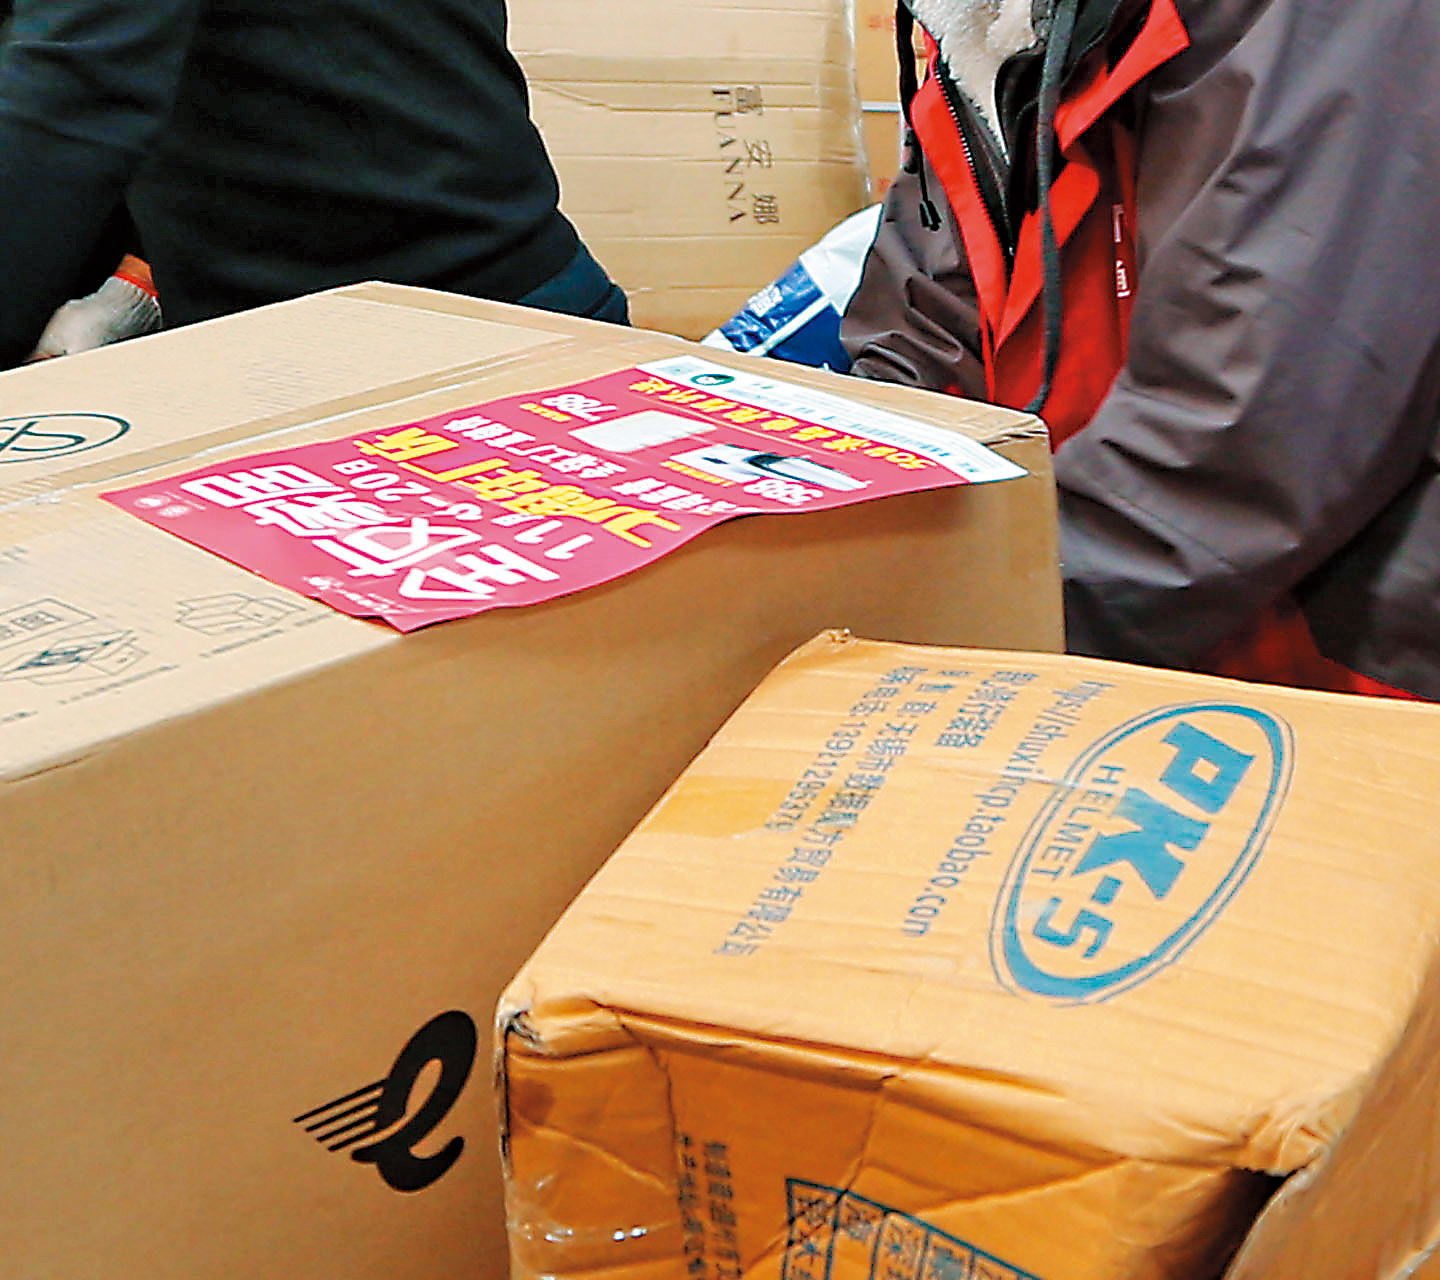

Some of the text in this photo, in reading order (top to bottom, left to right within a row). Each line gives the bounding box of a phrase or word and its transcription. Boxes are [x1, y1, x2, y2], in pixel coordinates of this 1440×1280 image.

[181, 465, 560, 600] 全友家居
[1034, 763, 1127, 882] HELMET
